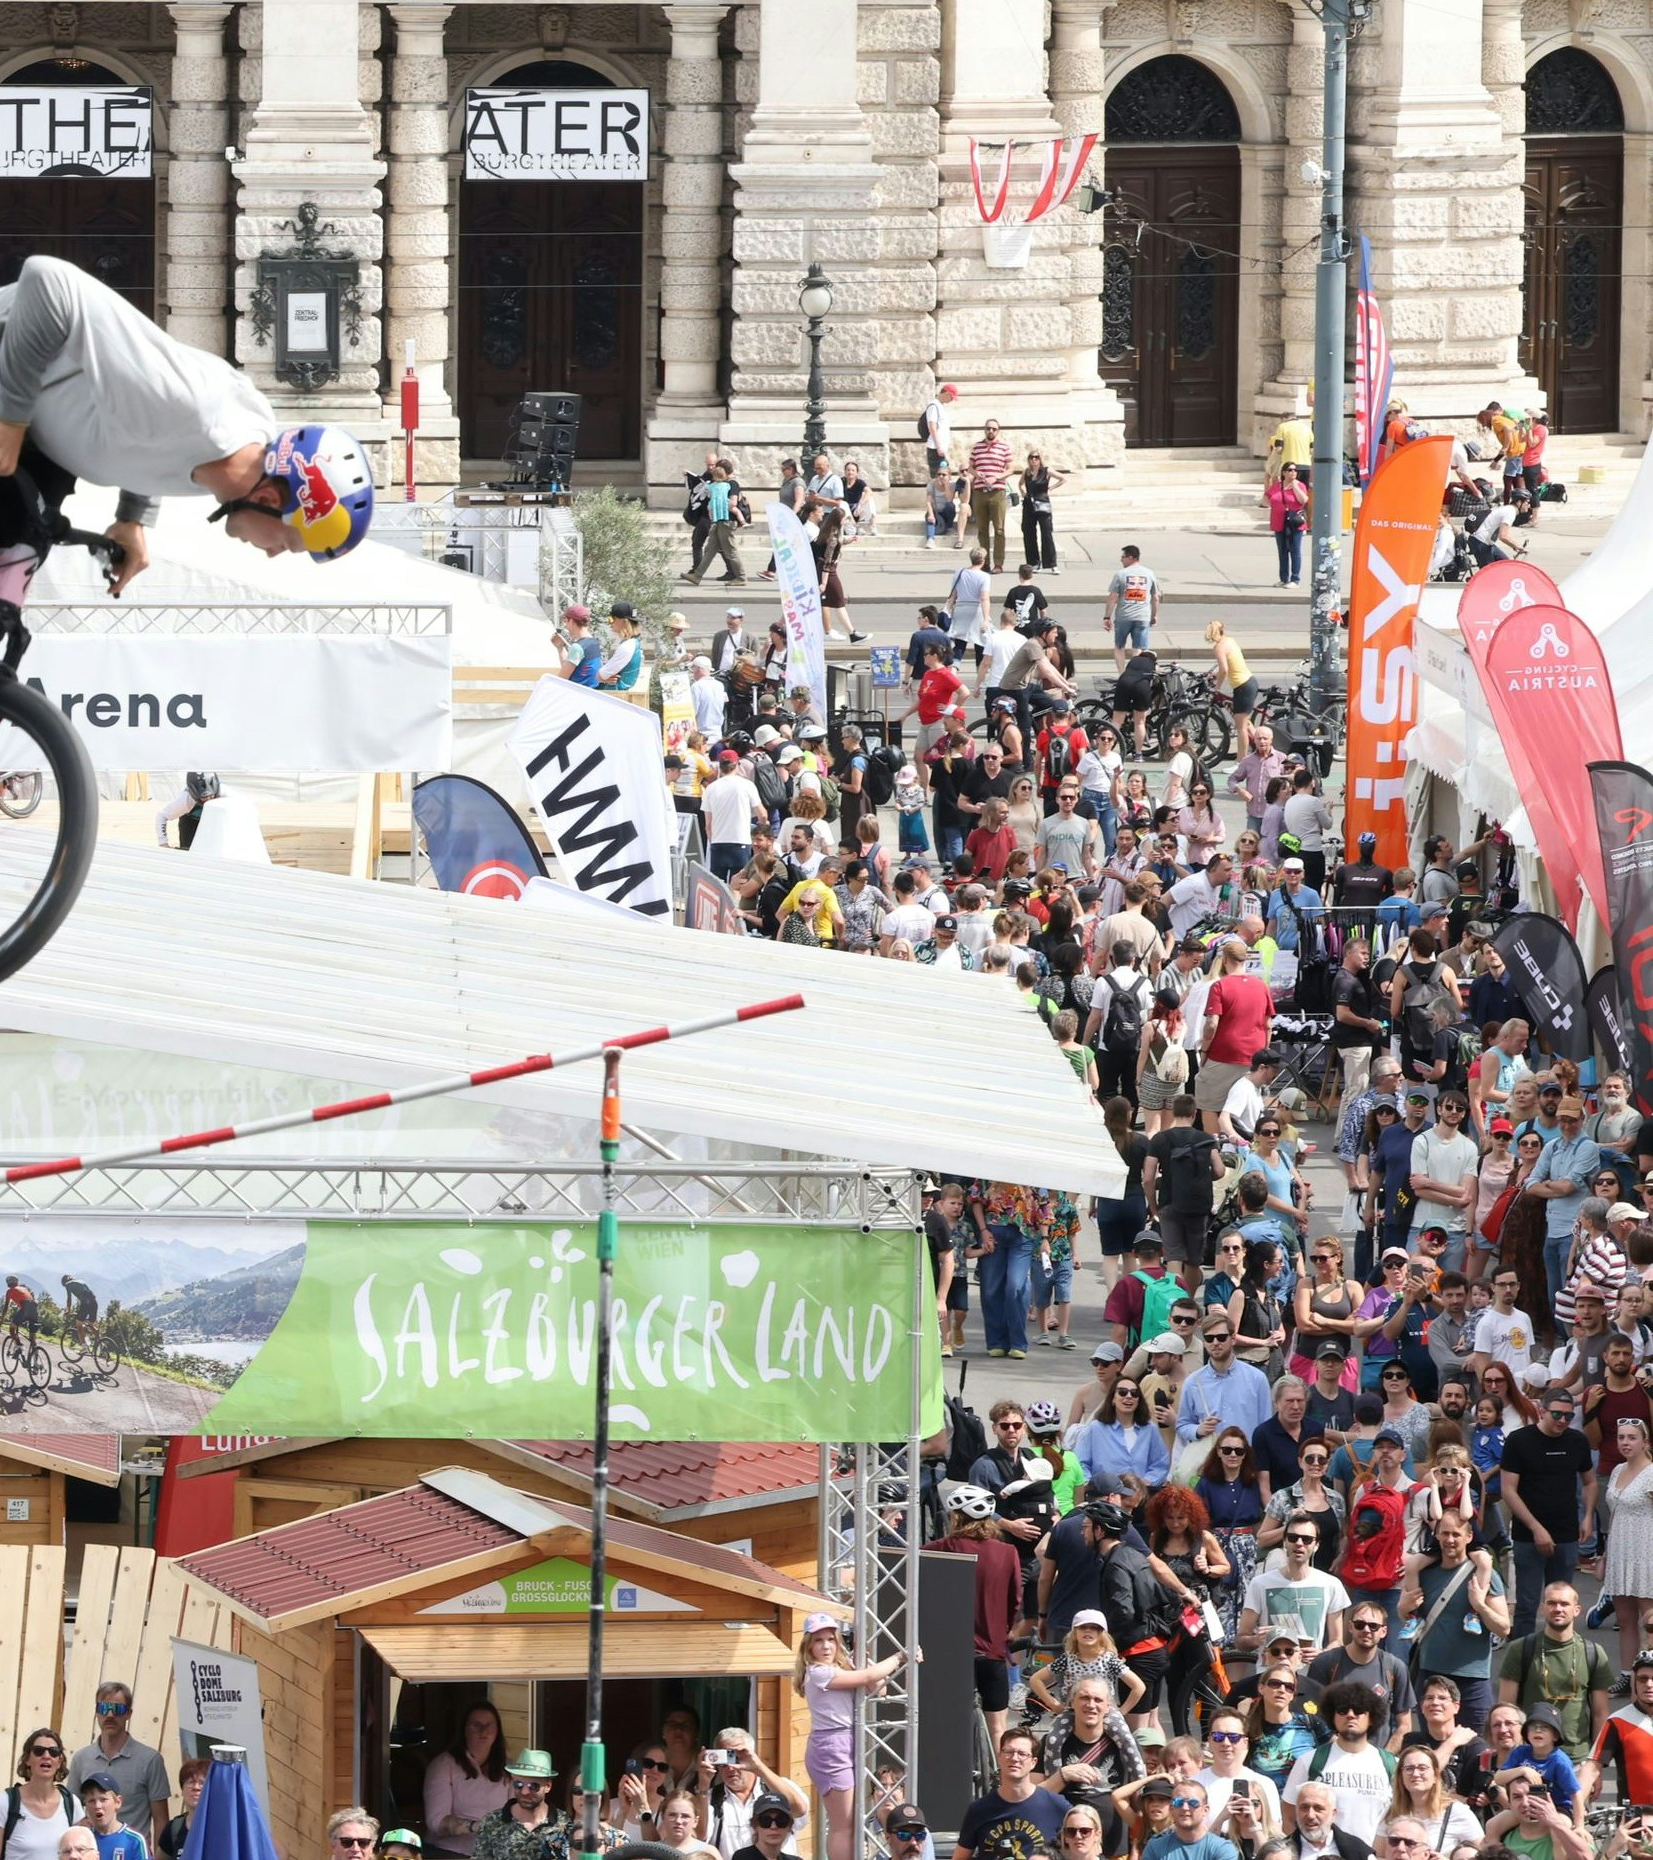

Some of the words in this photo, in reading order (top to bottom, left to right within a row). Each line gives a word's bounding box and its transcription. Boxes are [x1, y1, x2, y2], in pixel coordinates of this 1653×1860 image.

[467, 101, 640, 154] ATER
[473, 153, 640, 170] BURGTHEATER
[1371, 519, 1389, 527] DAS
[516, 1581, 555, 1592] BRUCK
[564, 1581, 593, 1592] FUSC
[511, 1592, 599, 1603] GROSSGLOCKN
[198, 1665, 221, 1677] CYCLO
[200, 1678, 222, 1689] DOME
[202, 1690, 242, 1702] SALZBURG
[1326, 1772, 1386, 1790] PLEASURES
